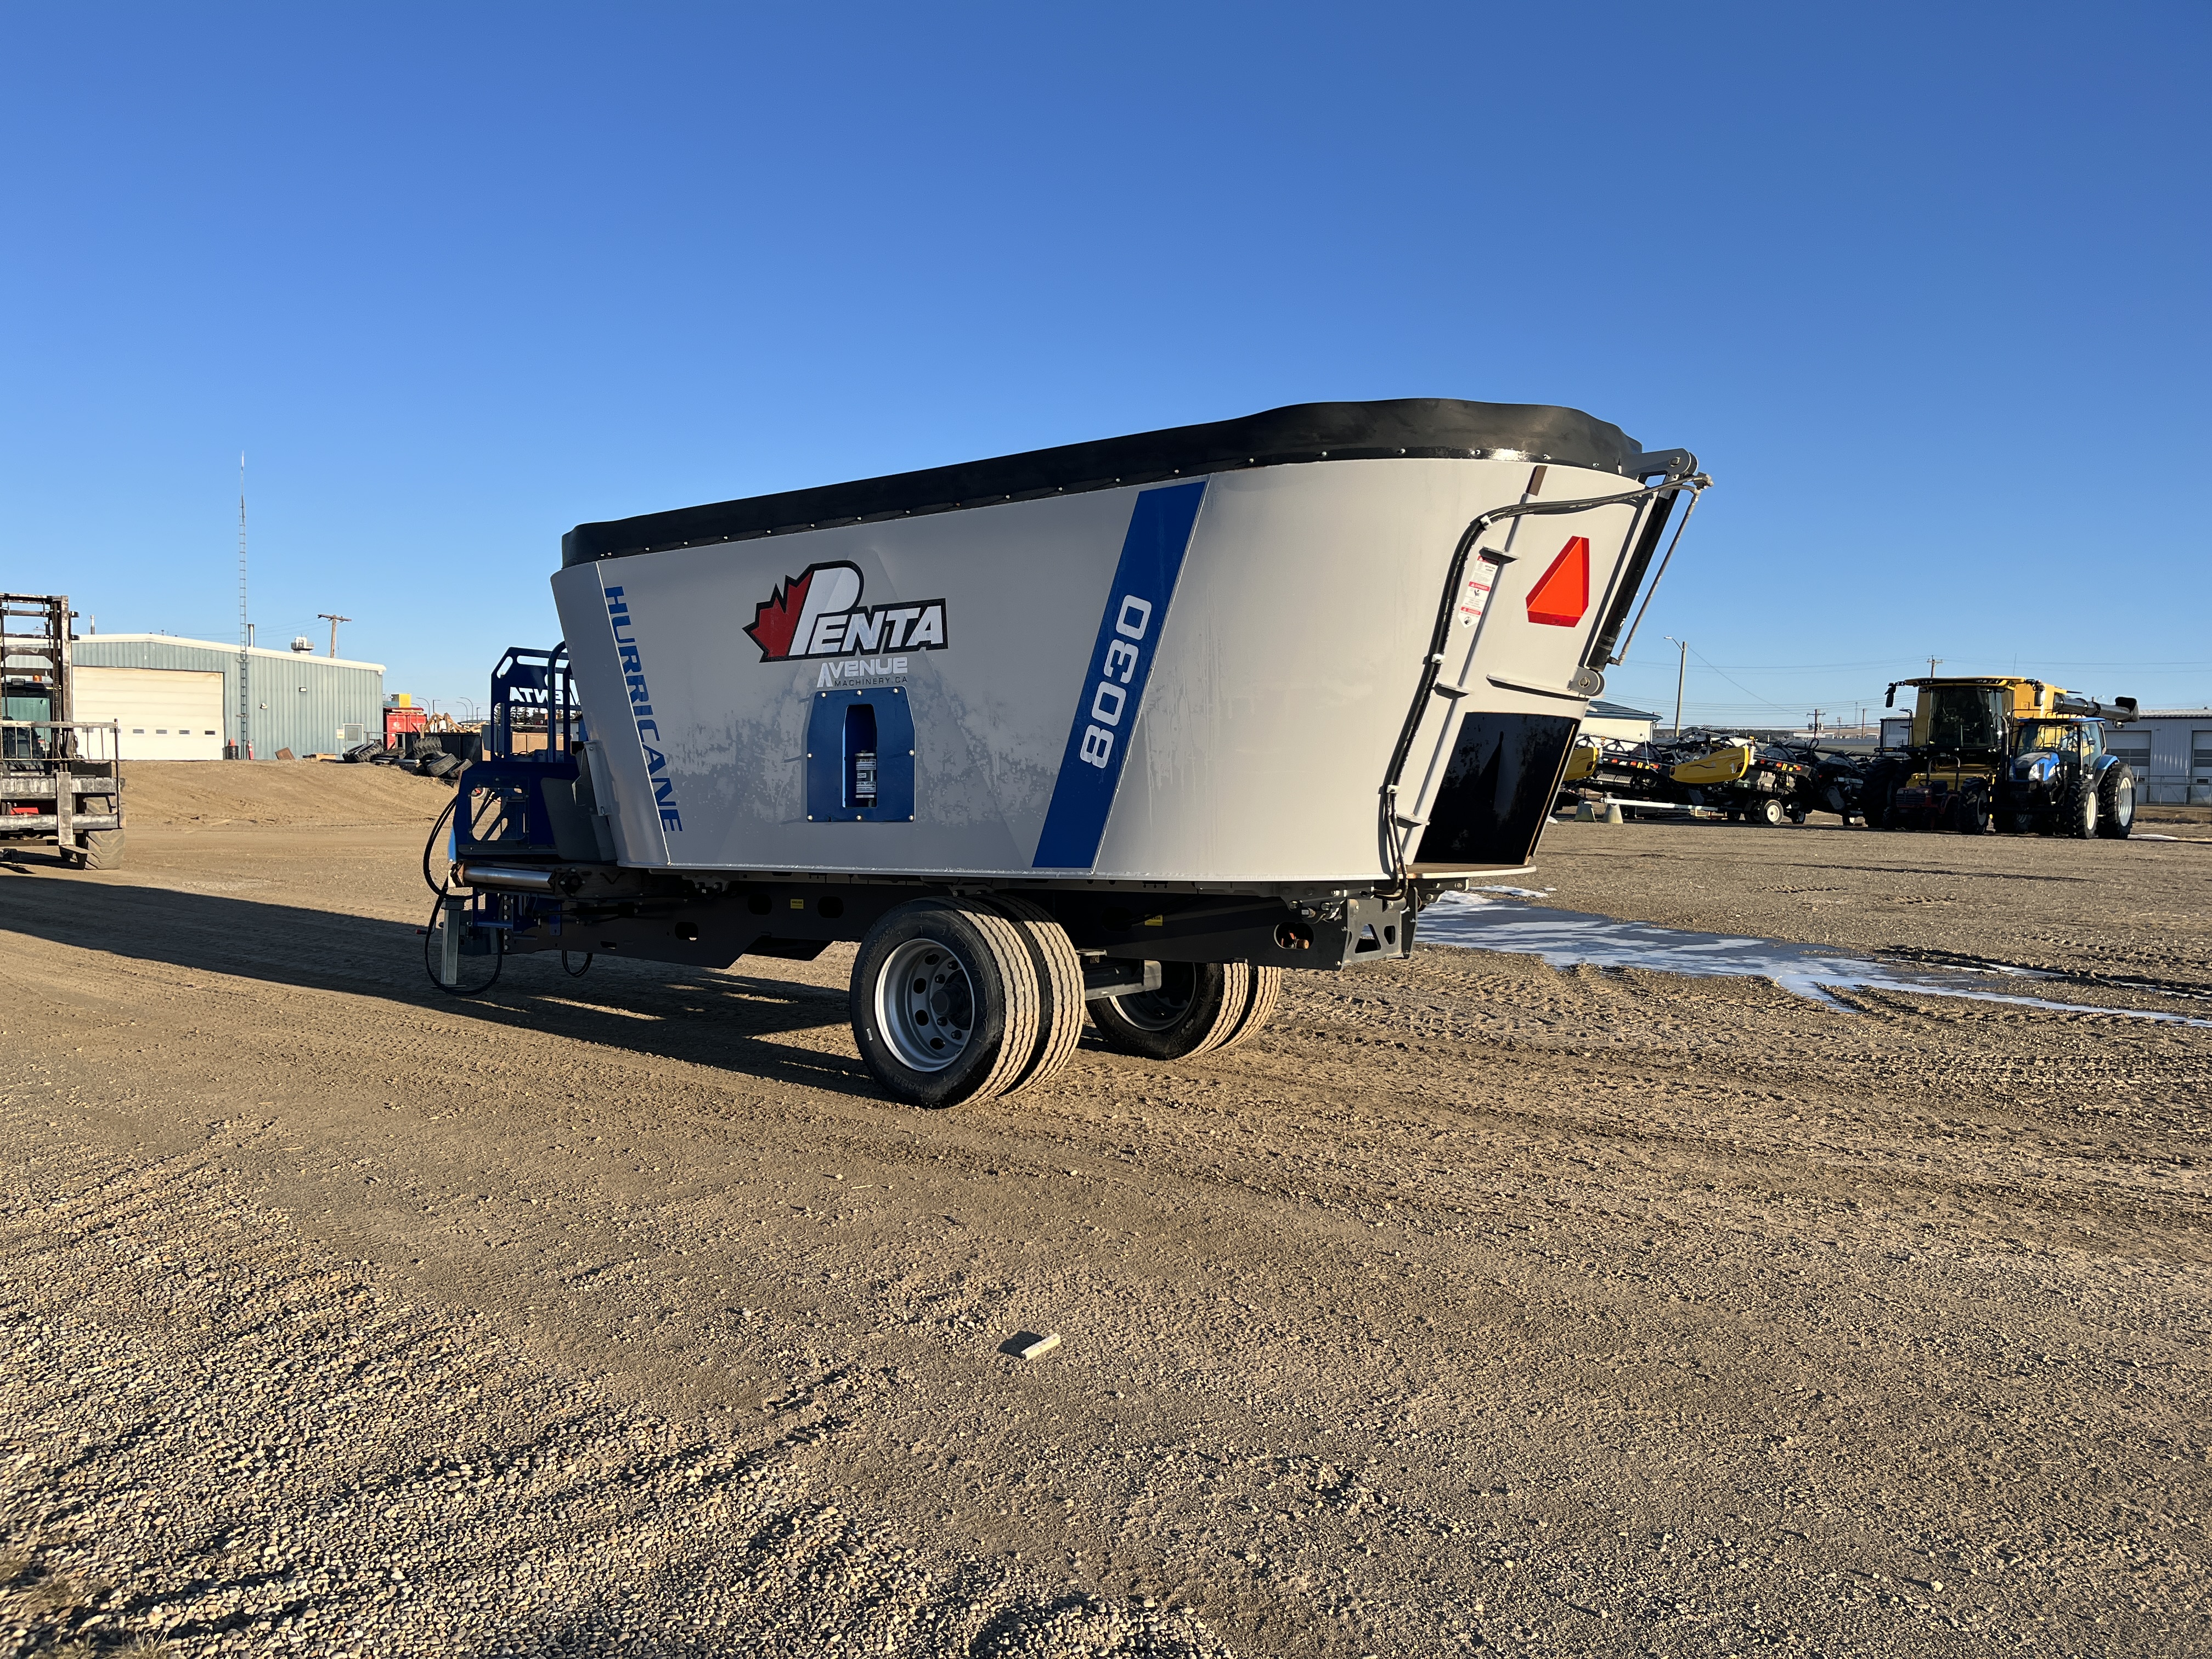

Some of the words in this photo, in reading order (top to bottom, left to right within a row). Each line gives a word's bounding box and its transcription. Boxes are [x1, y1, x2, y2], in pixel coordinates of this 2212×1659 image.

[788, 567, 944, 656] PENTA
[605, 586, 683, 832] HURRICANE
[834, 676, 909, 687] MACHINERY.CA
[1080, 595, 1152, 769] 8030
